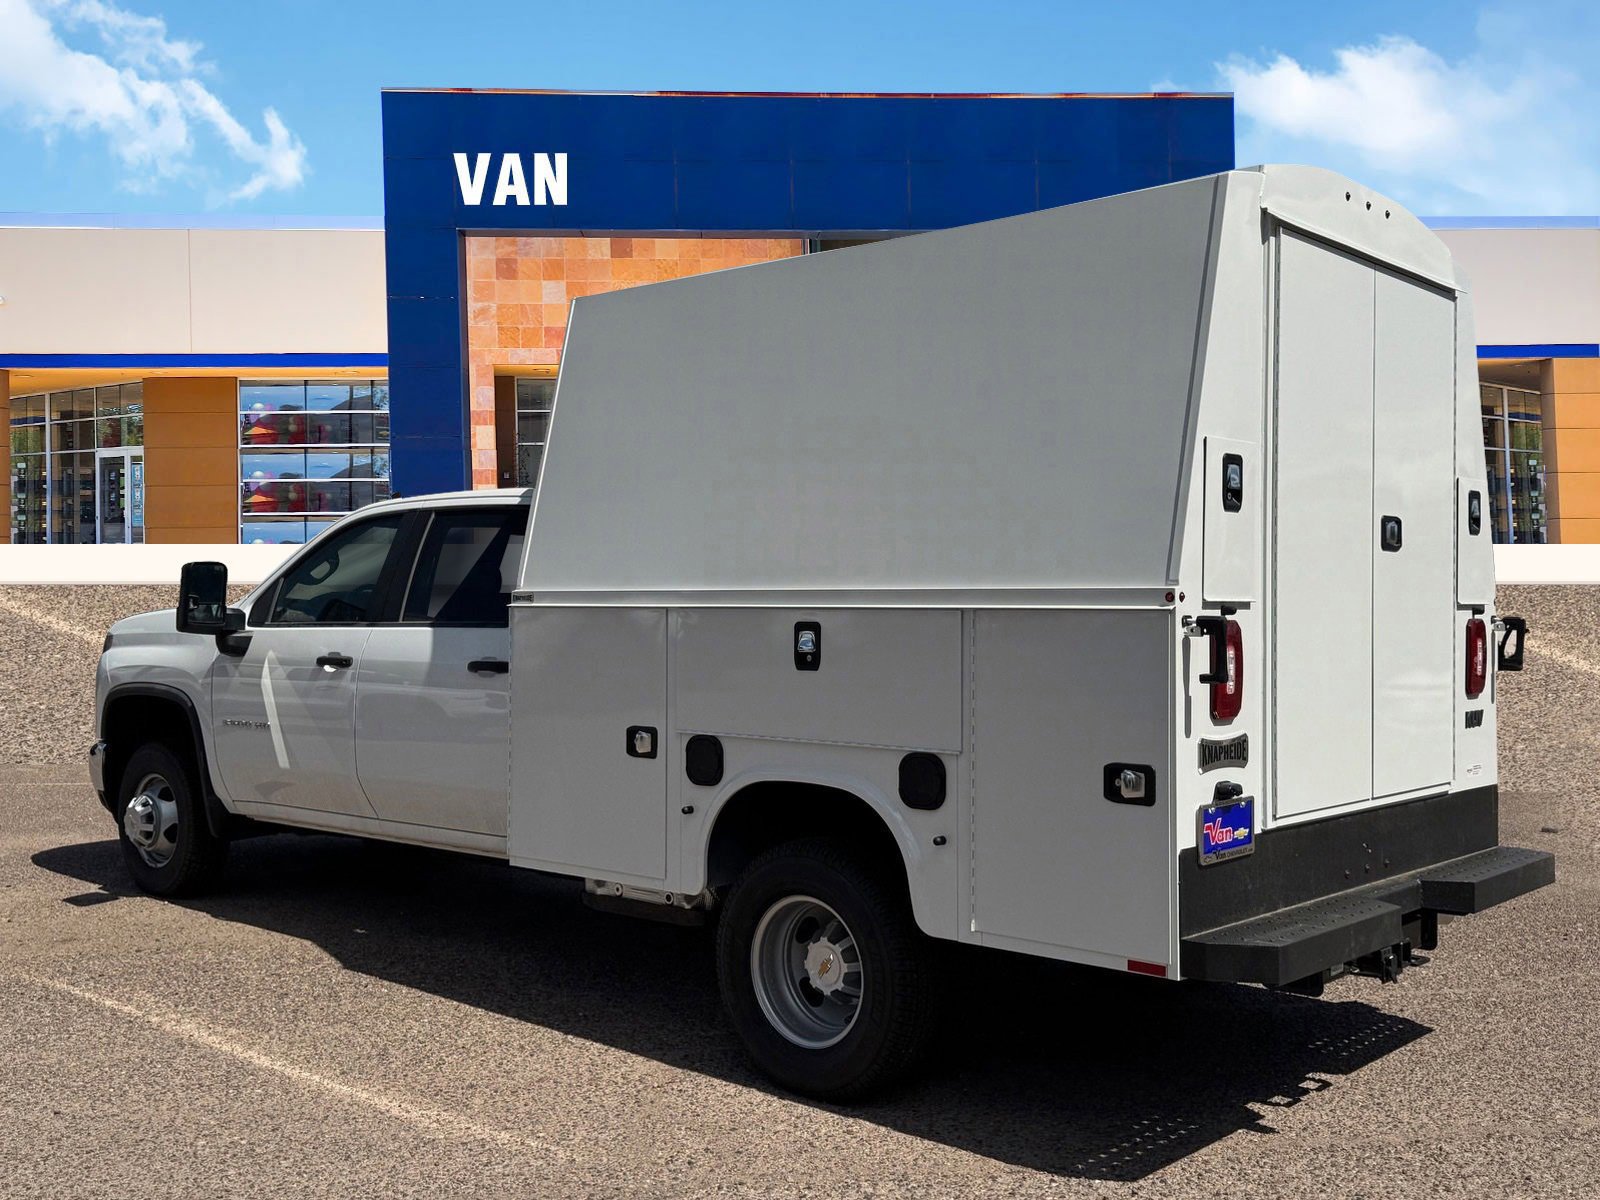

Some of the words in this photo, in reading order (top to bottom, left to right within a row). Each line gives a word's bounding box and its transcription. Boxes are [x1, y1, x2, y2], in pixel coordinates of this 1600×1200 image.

[453, 152, 568, 206] VAN
[1201, 739, 1247, 767] KNAPHEIDE
[1204, 818, 1233, 845] Van
